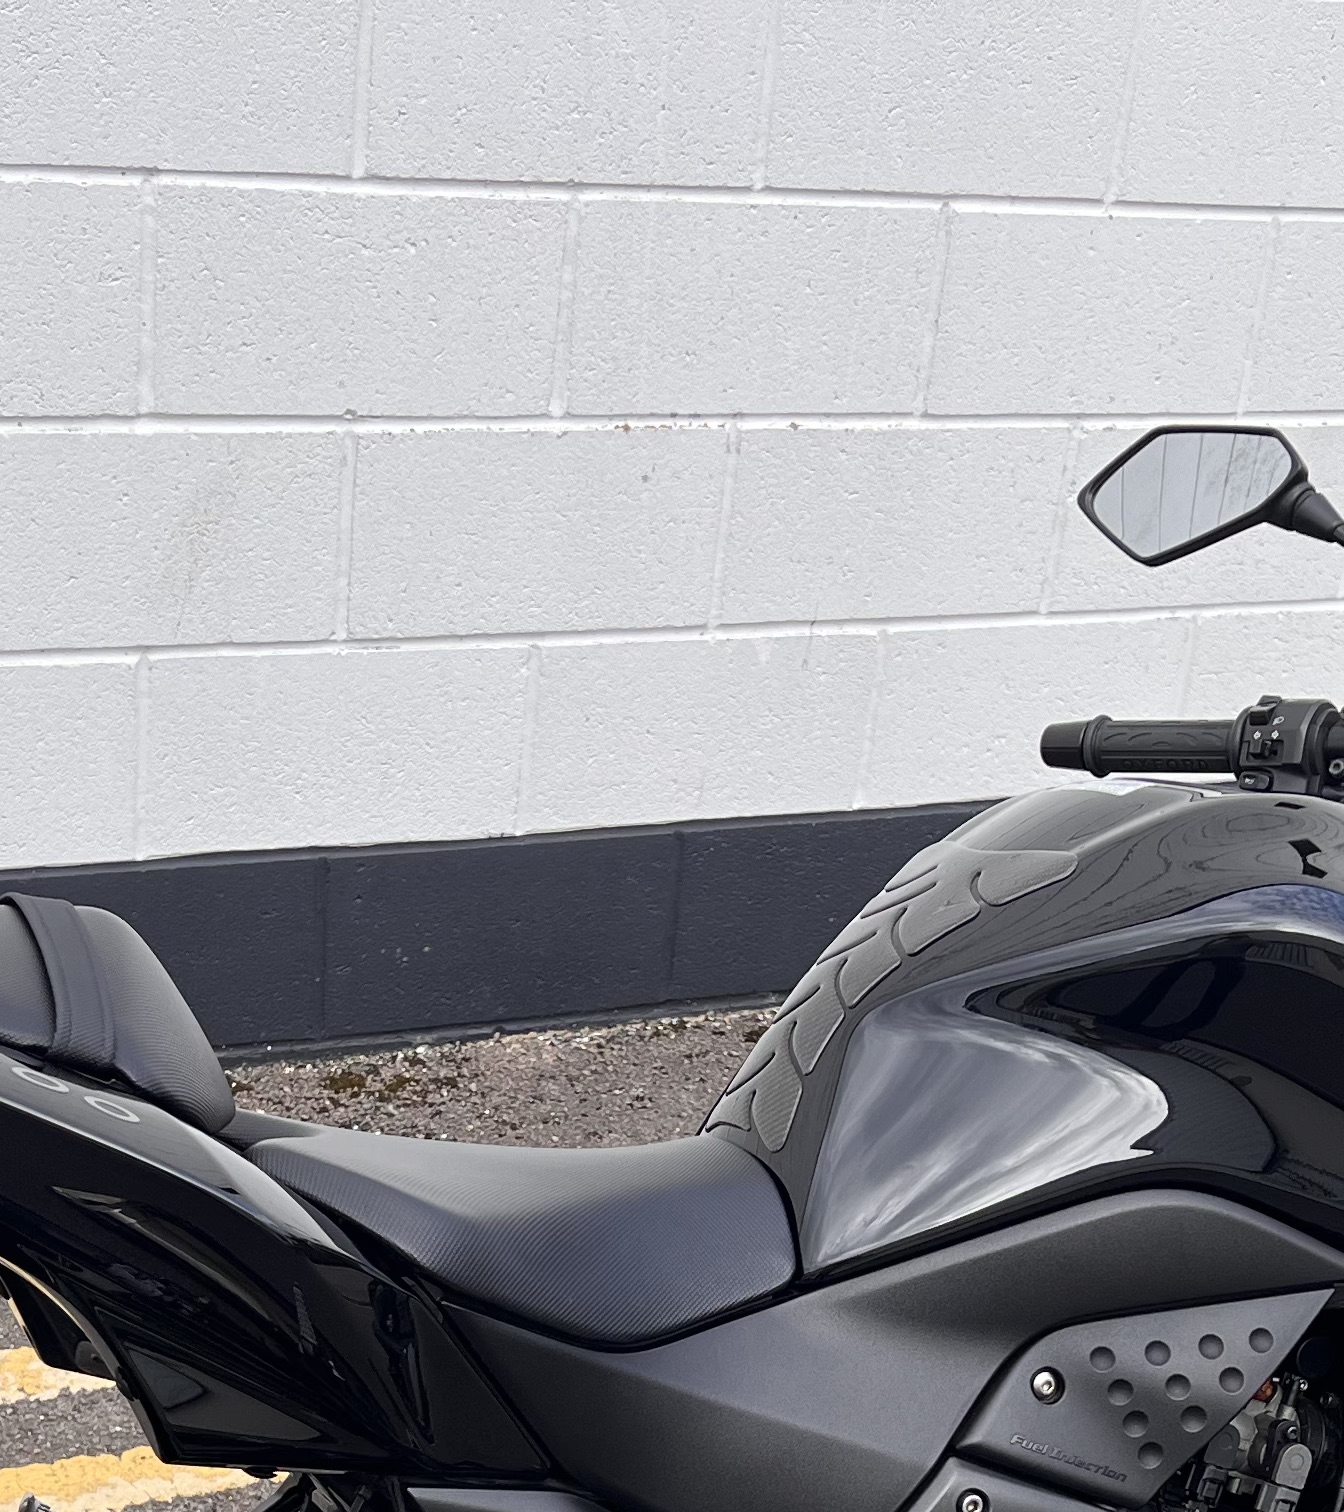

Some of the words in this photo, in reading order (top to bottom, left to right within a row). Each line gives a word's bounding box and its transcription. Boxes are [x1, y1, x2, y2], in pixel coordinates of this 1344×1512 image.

[1121, 758, 1209, 770] OXFORD
[1010, 1433, 1048, 1456] Fuel
[1050, 1445, 1128, 1483] Injection
